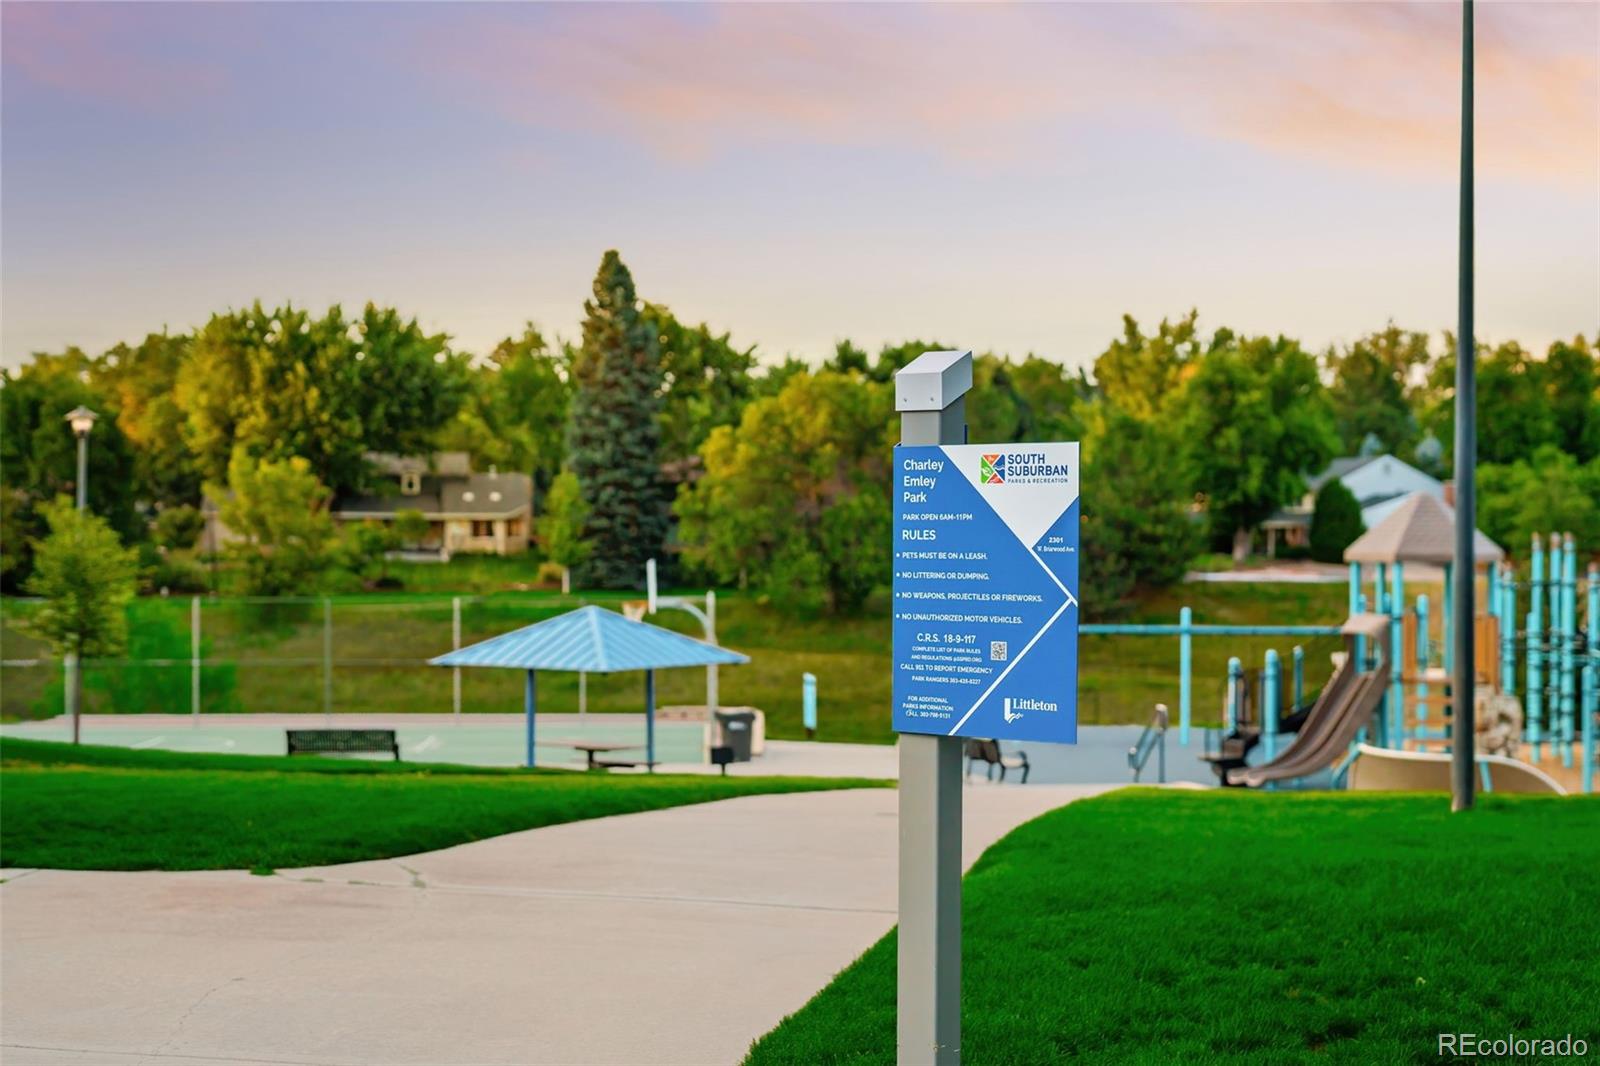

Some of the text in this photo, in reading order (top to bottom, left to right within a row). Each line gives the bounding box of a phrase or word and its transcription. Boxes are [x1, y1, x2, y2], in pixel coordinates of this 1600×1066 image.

[1008, 454, 1045, 465] SOUTH
[903, 459, 944, 472] Charley
[1008, 465, 1068, 476] SUBURBAN
[903, 476, 936, 488] Emley
[903, 492, 927, 503] Park
[902, 530, 936, 540] RULES
[913, 614, 963, 622] UNAUTHORIZED
[917, 633, 976, 643] C.R.S. 18-9-117
[1012, 698, 1058, 712] Littleton
